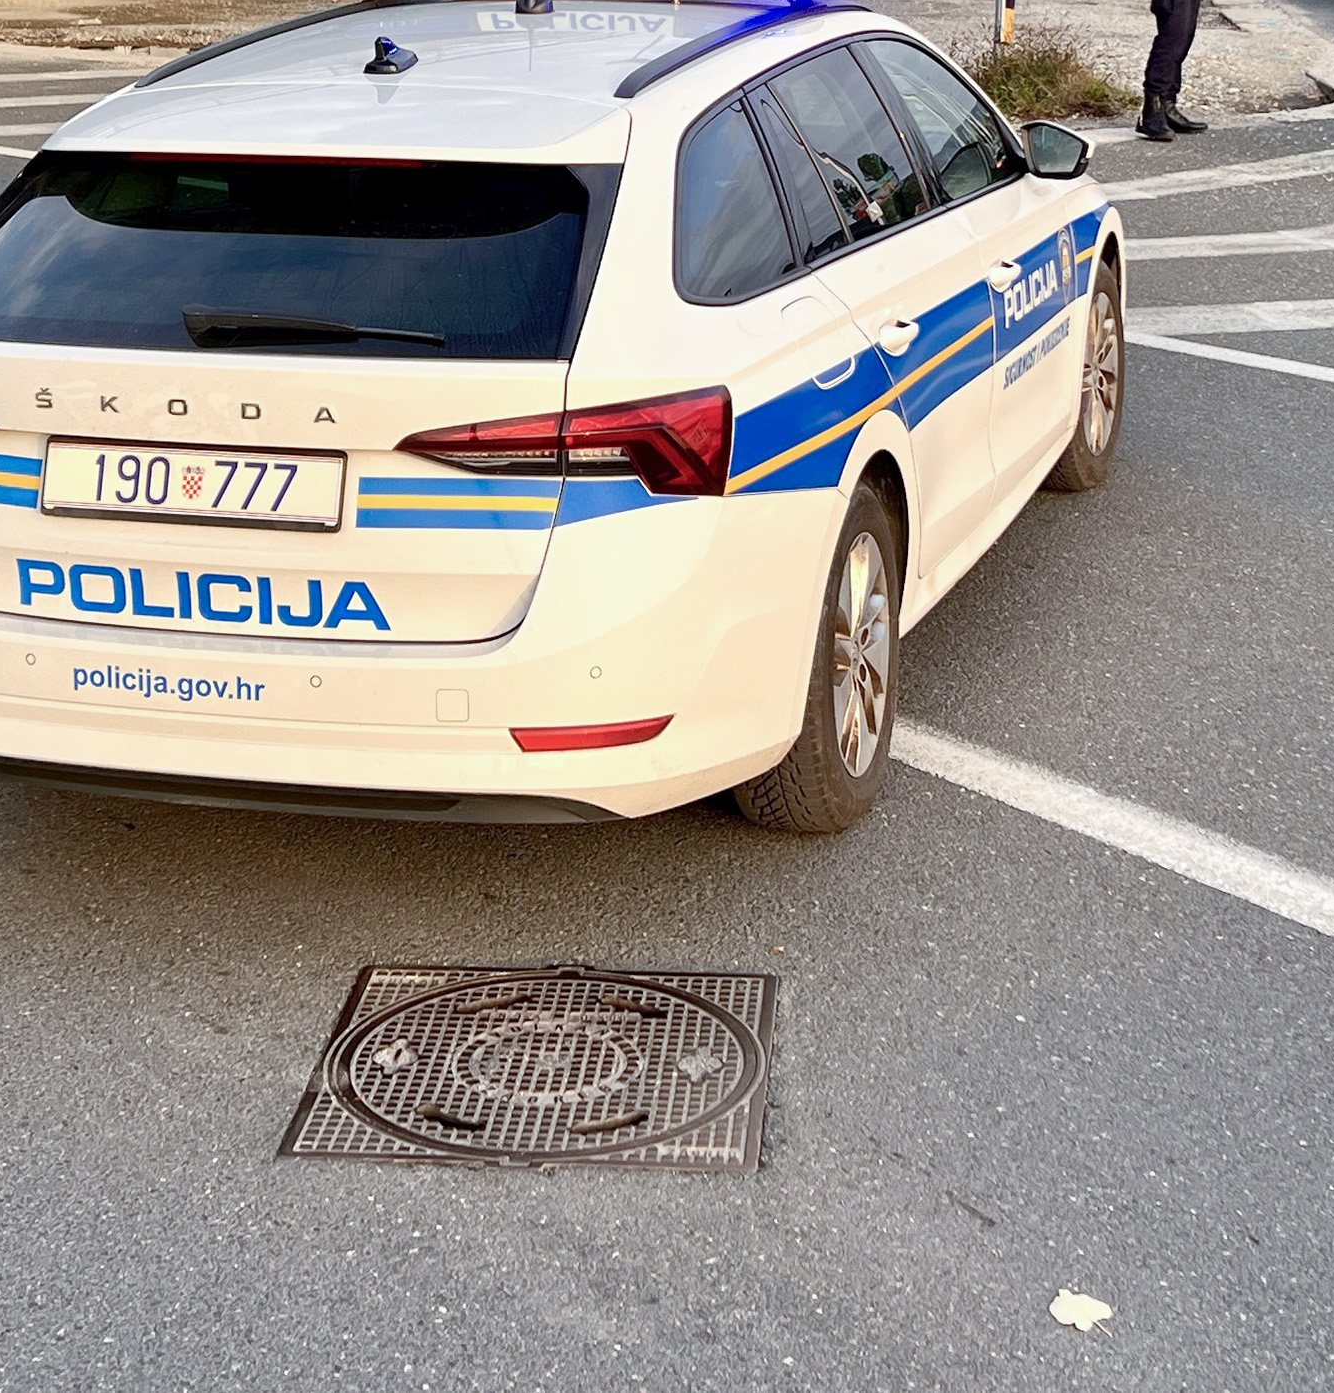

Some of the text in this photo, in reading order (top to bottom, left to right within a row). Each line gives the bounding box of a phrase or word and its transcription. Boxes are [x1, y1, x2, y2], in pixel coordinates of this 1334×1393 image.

[1003, 259, 1058, 329] POLICIJA
[35, 387, 337, 424] ŠKODA
[94, 454, 298, 513] 190 777
[16, 558, 391, 631] POLICIJA
[73, 664, 266, 702] policija.gov.hr
